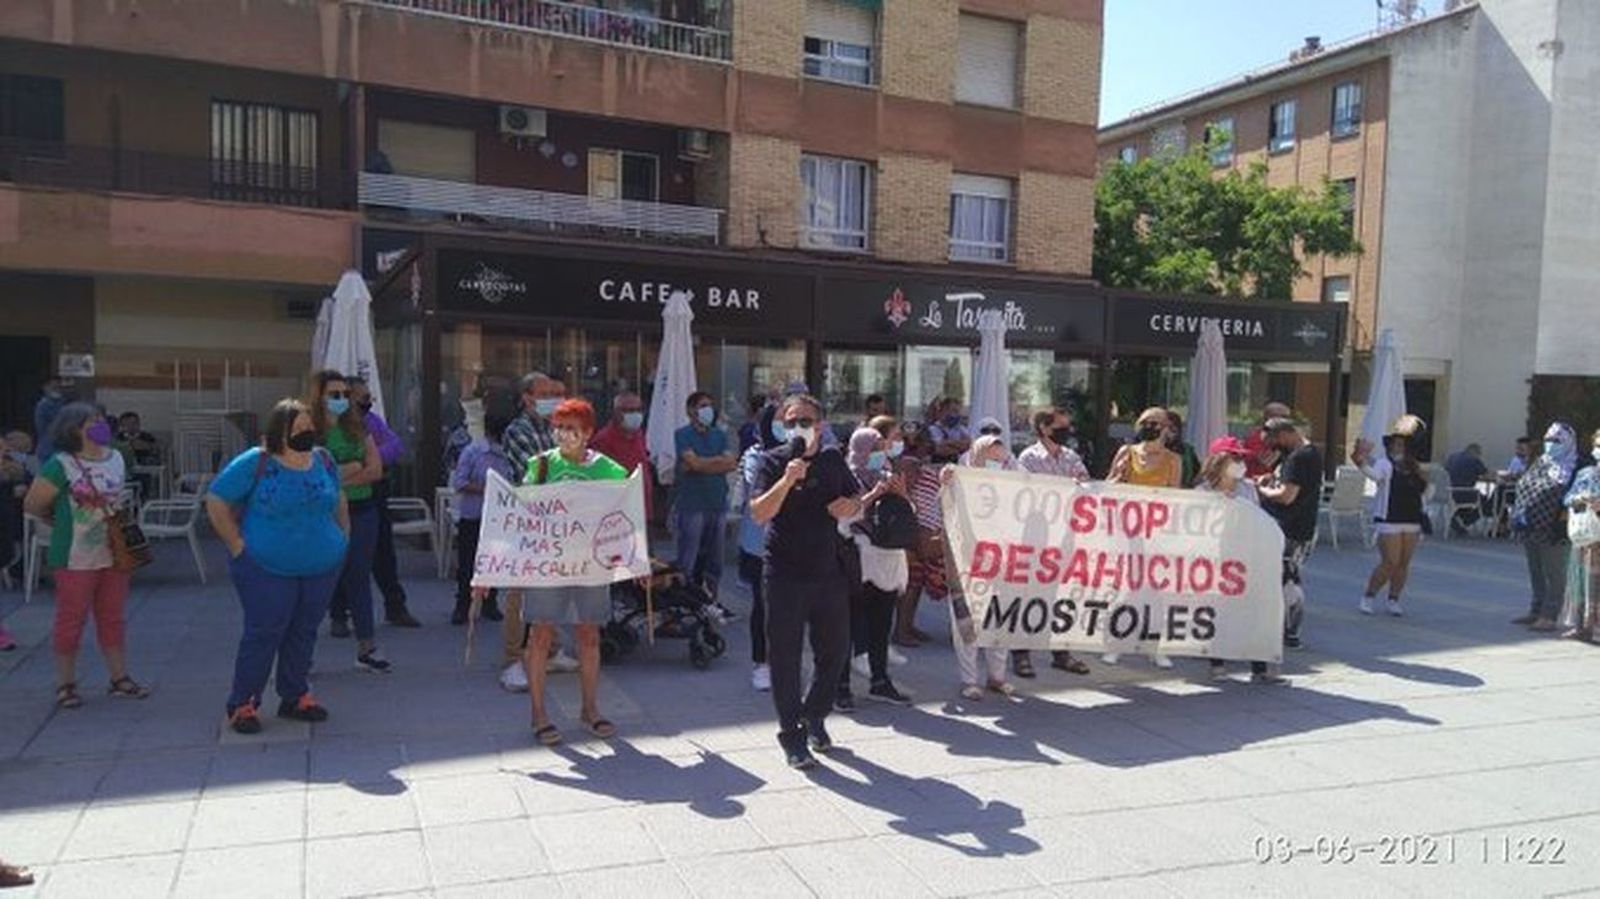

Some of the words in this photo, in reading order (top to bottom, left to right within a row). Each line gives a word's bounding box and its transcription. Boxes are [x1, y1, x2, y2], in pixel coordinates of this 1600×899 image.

[599, 280, 672, 302] CAFE
[708, 287, 760, 310] BAR
[945, 292, 1026, 331] Taita
[1150, 314, 1264, 337] CERVEERIA
[1070, 495, 1170, 539] STOP
[518, 535, 564, 558] MAS
[970, 540, 1247, 597] DESAHUCIOS
[982, 594, 1217, 642] MOSTOLES
